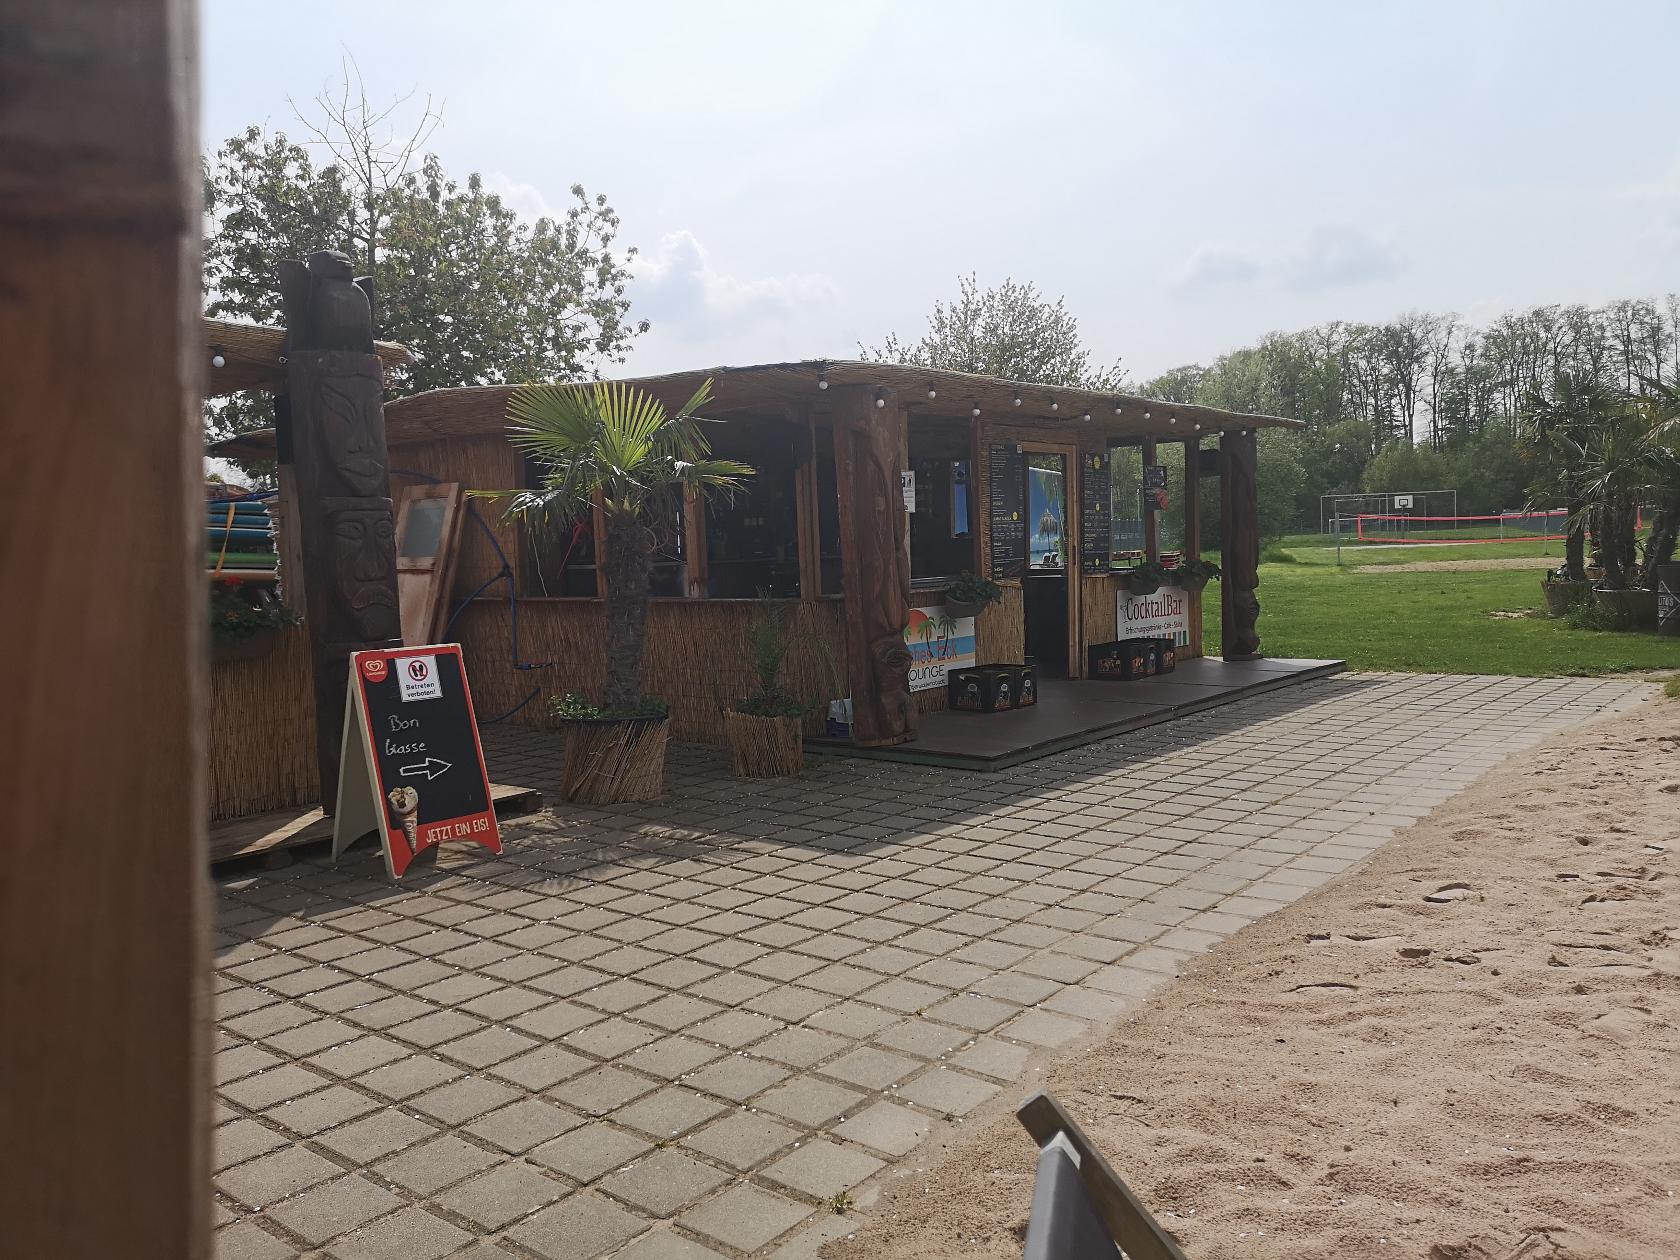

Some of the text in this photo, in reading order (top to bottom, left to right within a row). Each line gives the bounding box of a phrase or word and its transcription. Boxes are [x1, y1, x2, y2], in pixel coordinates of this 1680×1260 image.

[405, 682, 435, 691] Betreten
[387, 714, 419, 732] Bon
[426, 817, 490, 843] JETZT EIN EIS!
